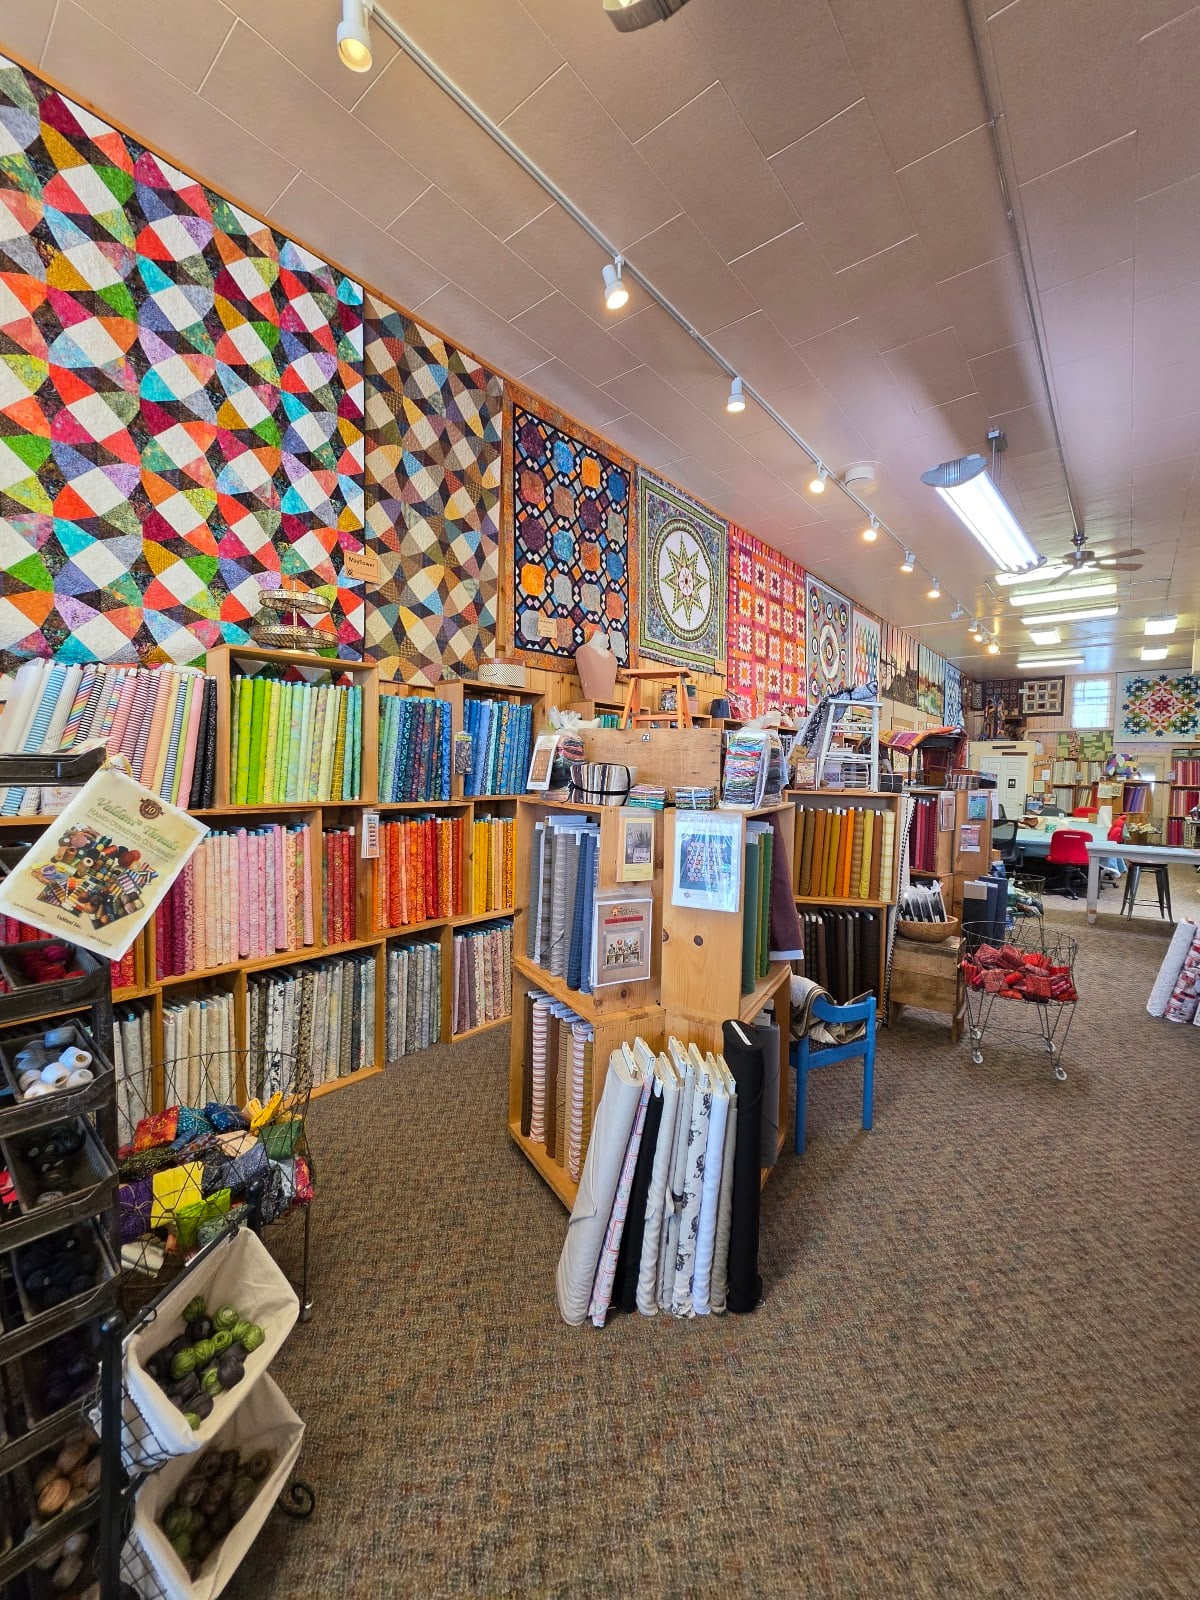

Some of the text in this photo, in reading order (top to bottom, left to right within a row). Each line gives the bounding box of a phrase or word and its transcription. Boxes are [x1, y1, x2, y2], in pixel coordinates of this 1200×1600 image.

[348, 556, 375, 568] Mayflower
[145, 805, 156, 814] 10
[143, 825, 179, 851] Threads
